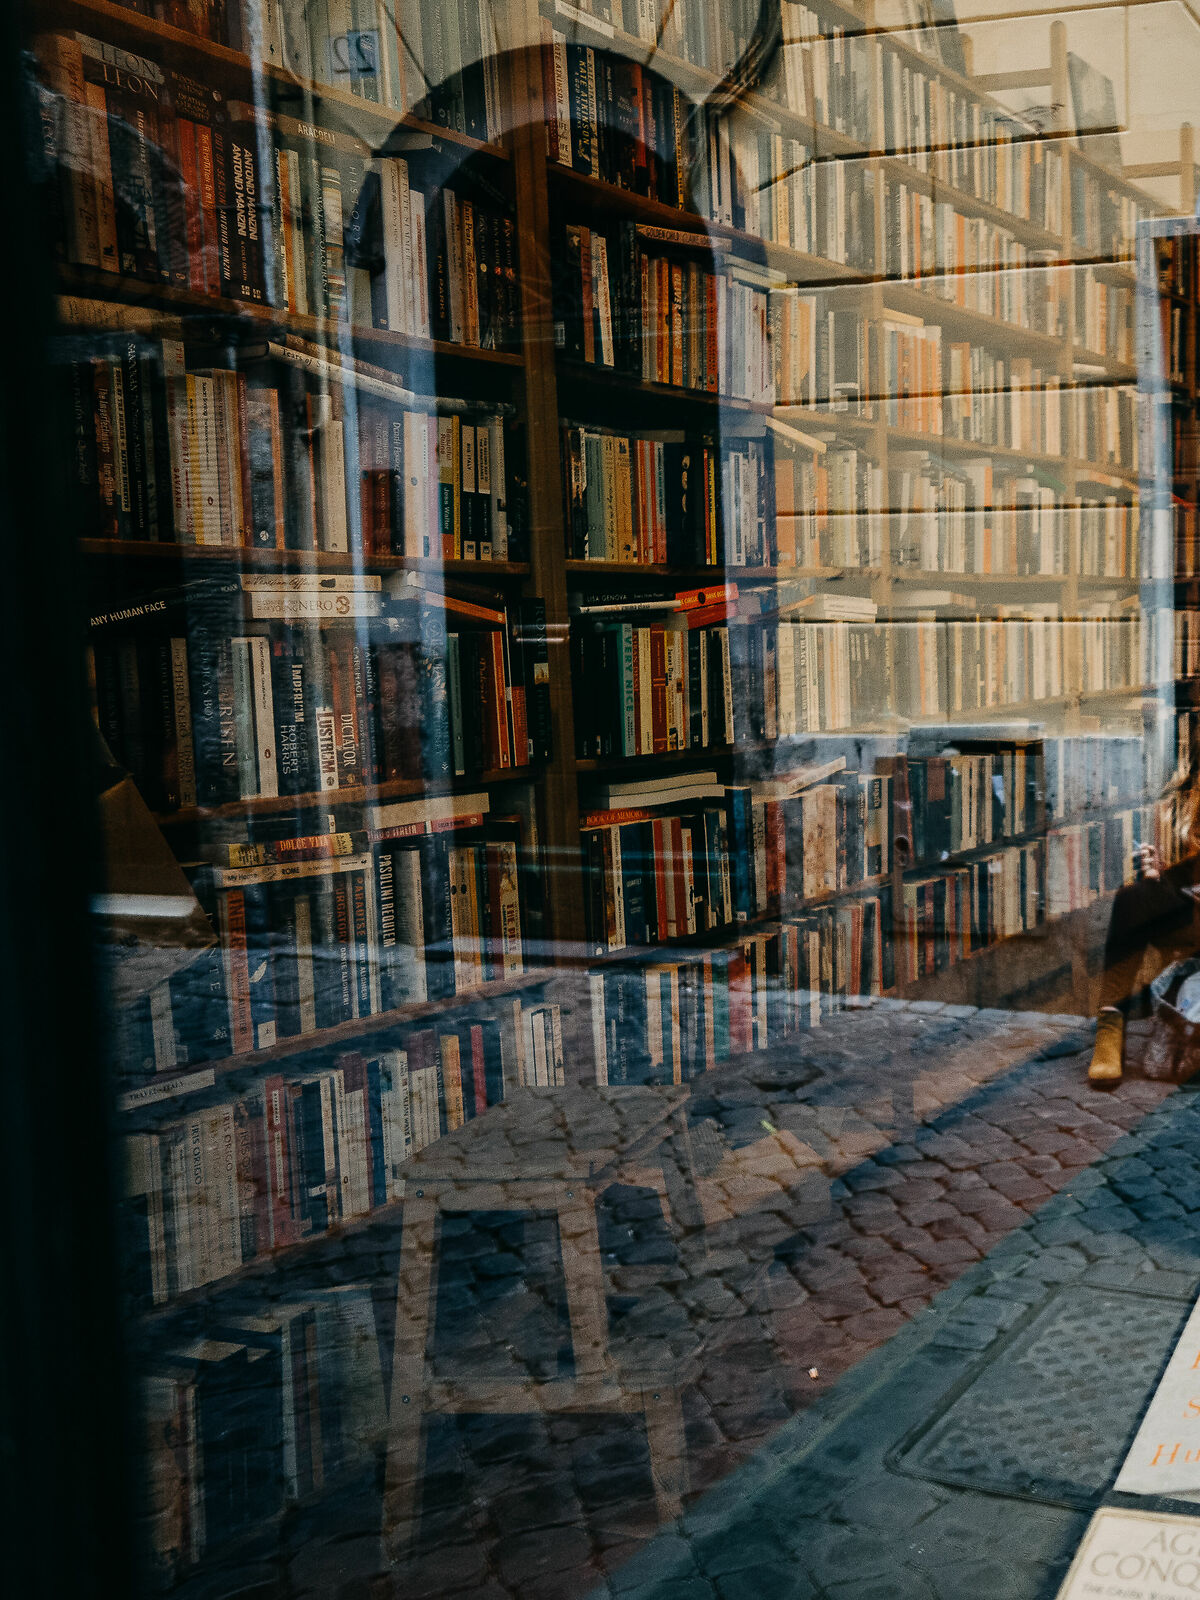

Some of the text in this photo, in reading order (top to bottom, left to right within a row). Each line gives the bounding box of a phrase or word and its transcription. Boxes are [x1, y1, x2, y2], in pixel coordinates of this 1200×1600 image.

[103, 64, 158, 99] LEON
[232, 143, 246, 237] ANTONIO MANZINI
[244, 148, 258, 240] ANTONIO MANZINI
[89, 600, 166, 628] ANY HUMAN FACE
[298, 601, 333, 612] NERO
[624, 637, 634, 712] VERY NICE
[281, 725, 291, 774] HARRIS
[289, 725, 298, 773] ROBERT
[340, 714, 355, 766] DICTATOR
[280, 838, 306, 851] DOLCE
[379, 855, 396, 947] PASOLINI REQUIEM
